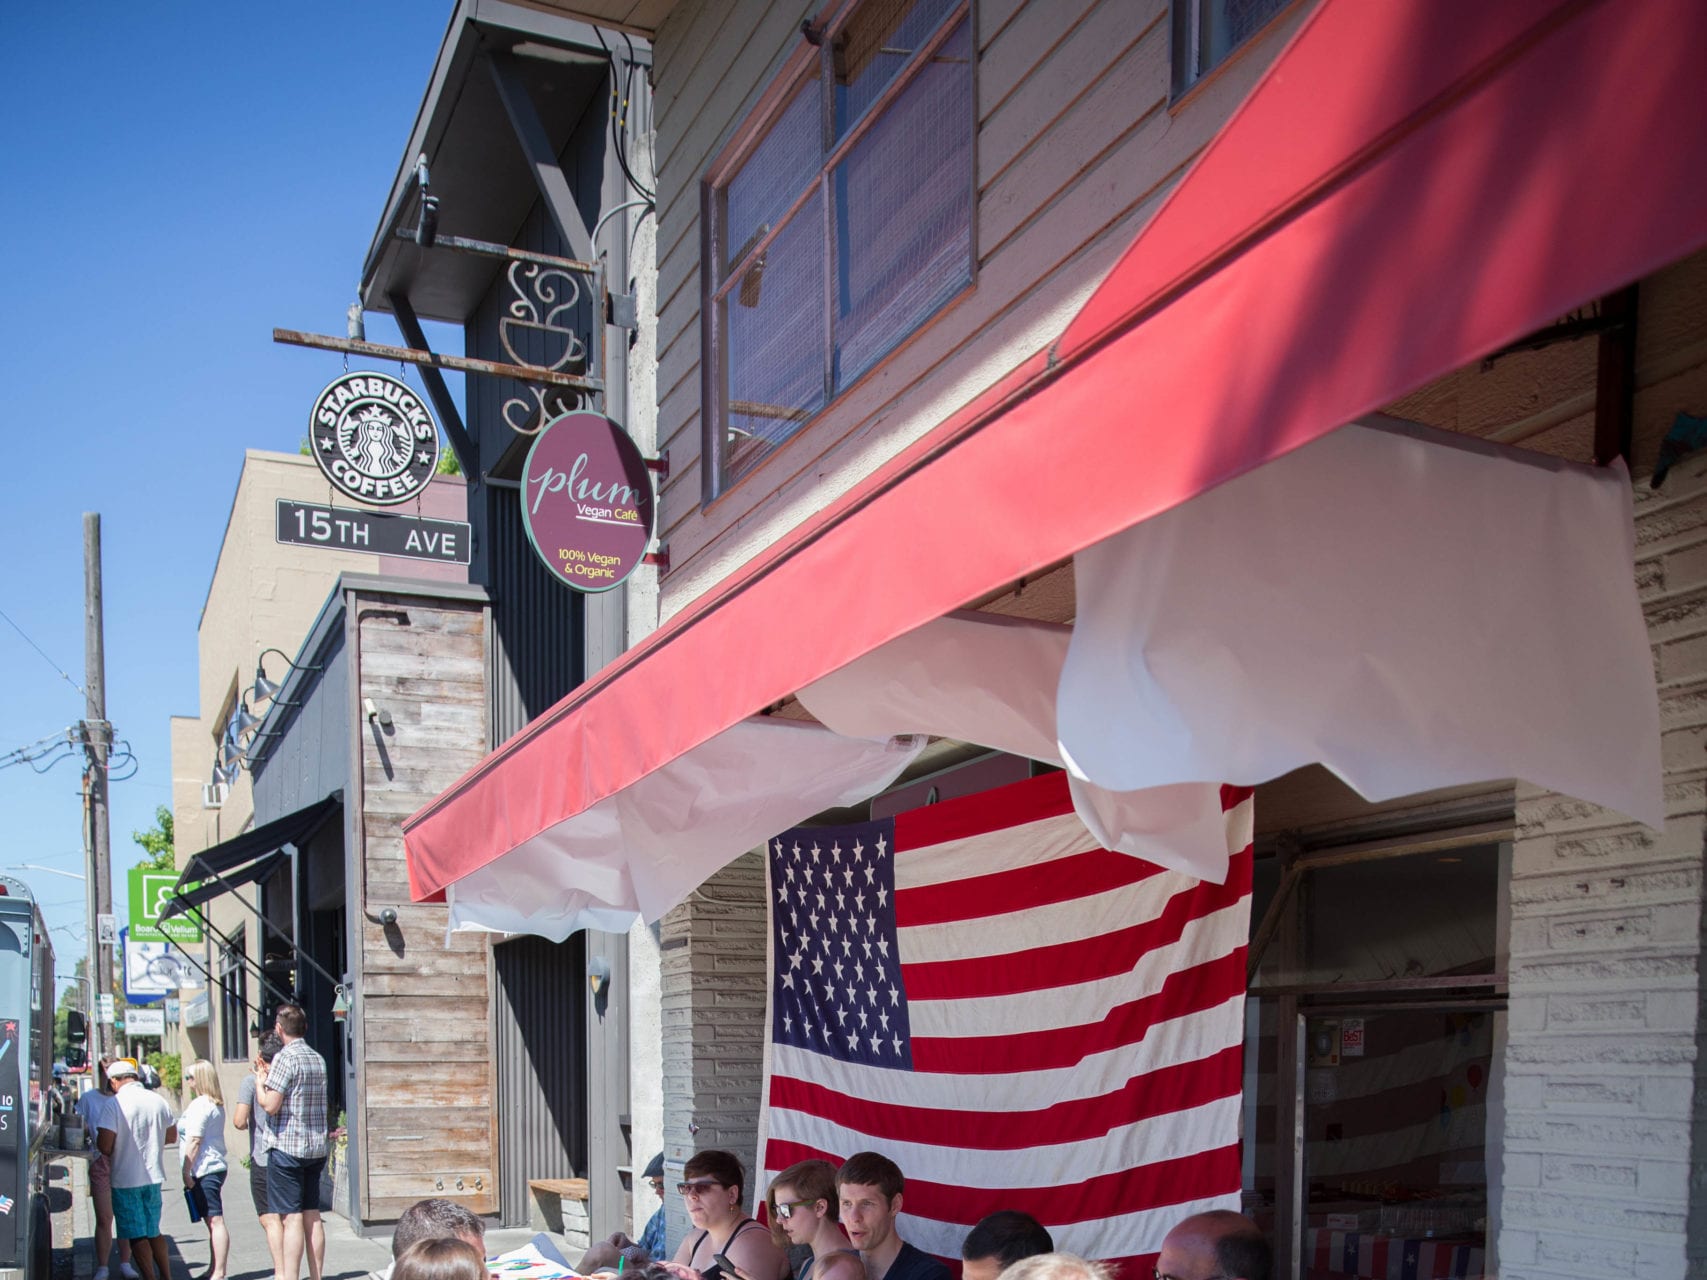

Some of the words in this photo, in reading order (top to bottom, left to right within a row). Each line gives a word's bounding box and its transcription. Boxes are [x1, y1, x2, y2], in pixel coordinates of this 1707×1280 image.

[318, 377, 432, 441] STARBUCKS
[331, 459, 420, 498] COFFEE
[529, 453, 646, 514] plum
[576, 503, 612, 520] Vegan
[614, 506, 638, 521] Café
[294, 508, 370, 546] 15TH
[404, 529, 456, 556] AVE
[558, 548, 585, 561] 100%
[587, 551, 621, 567] Vegan
[564, 563, 574, 574] &
[575, 563, 615, 579] Organic
